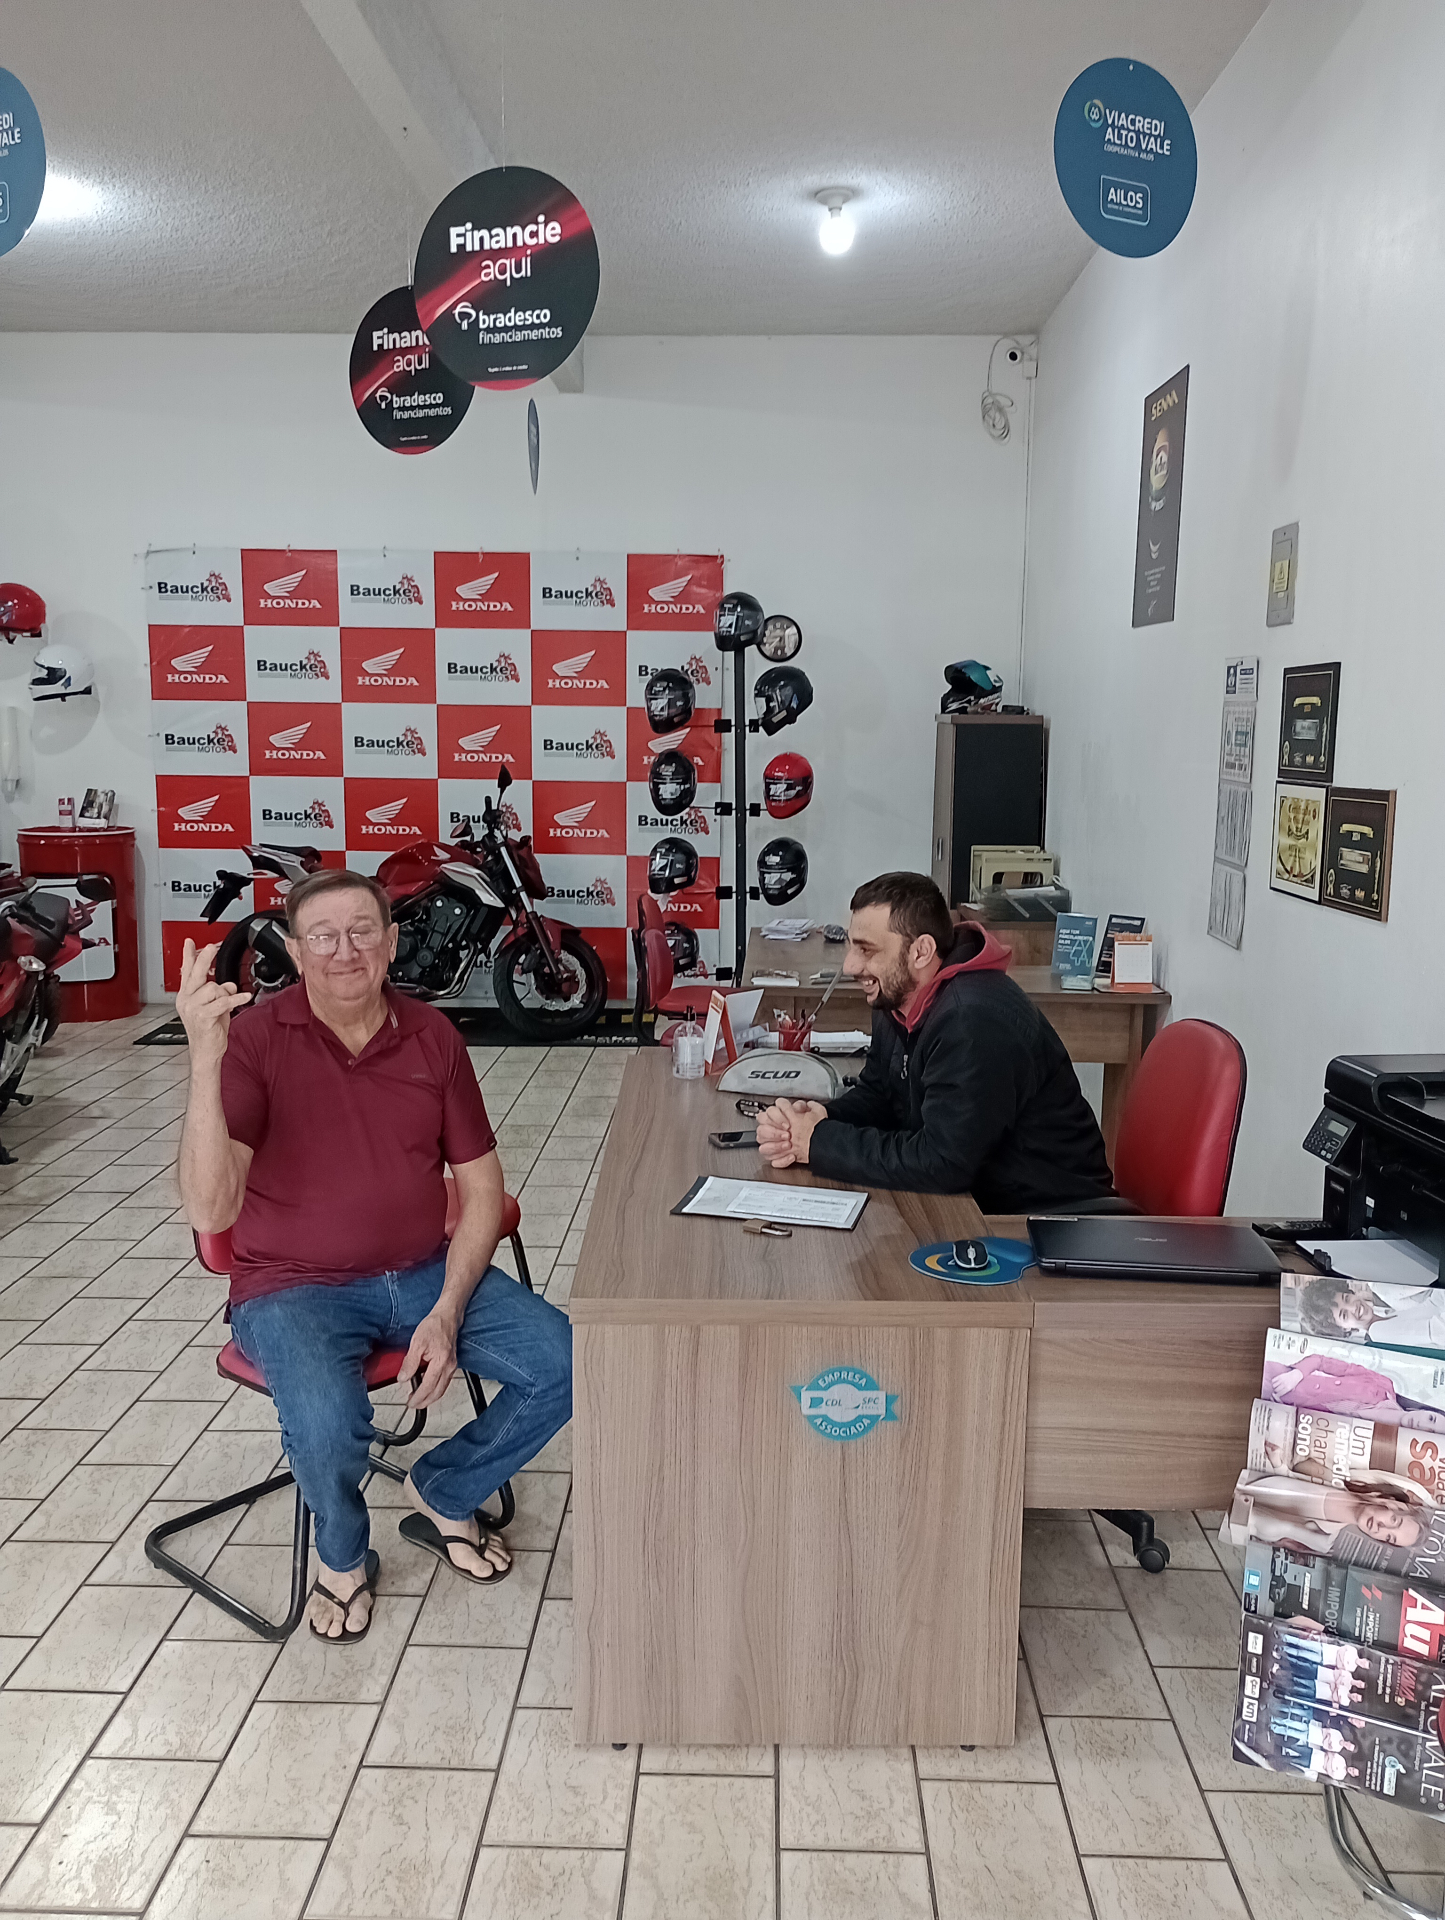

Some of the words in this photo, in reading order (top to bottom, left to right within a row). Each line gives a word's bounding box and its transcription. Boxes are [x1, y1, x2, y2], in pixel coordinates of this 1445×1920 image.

[1105, 108, 1164, 136] VIACREDI
[1105, 127, 1136, 147] ALTO
[1140, 134, 1171, 155] VALE
[1104, 143, 1138, 158] COOPERATIVA
[1108, 187, 1143, 209] AILOS
[449, 214, 562, 253] Financie
[480, 250, 532, 287] aqui
[478, 308, 550, 329] bradesco
[478, 326, 562, 345] financiamentos
[393, 348, 430, 376] aqui
[392, 390, 443, 408] bradesco
[393, 404, 452, 420] financiamentos
[157, 582, 220, 595] Baucke
[350, 585, 412, 597] Baucke
[542, 587, 604, 600] Baucke
[259, 599, 322, 609] HONDA
[451, 601, 513, 611] HONDA
[643, 604, 705, 614] HONDA
[257, 660, 318, 672] Baucke
[447, 662, 509, 675] Baucke
[638, 665, 699, 678] Bake
[166, 674, 229, 684] HONDA
[357, 676, 419, 686] HONDA
[548, 679, 609, 689] HONDA
[165, 734, 226, 746] Baucke
[354, 736, 415, 749] Baucke
[543, 739, 605, 751] Baucke
[264, 750, 326, 760] HONDA
[453, 753, 515, 763] HONDA
[262, 809, 323, 821] Baucke
[450, 812, 481, 823] Bau
[637, 815, 699, 828] Baucke
[173, 823, 235, 832] HONDA
[360, 826, 423, 835] HONDA
[549, 828, 610, 838] HONDA
[171, 881, 222, 893] Bauck
[547, 886, 605, 899] Baucke
[667, 903, 703, 912] NDA
[748, 1071, 801, 1079] SCUD
[818, 1371, 867, 1388] EMPRESA
[825, 1399, 842, 1407] CDL
[862, 1397, 879, 1405] SPC
[813, 1418, 871, 1437] ASSOCIADA
[1296, 1413, 1313, 1457] sono
[1351, 1425, 1373, 1457] Um
[1311, 1417, 1334, 1485] cham
[1331, 1421, 1351, 1488] remédio
[1245, 1702, 1256, 1718] km
